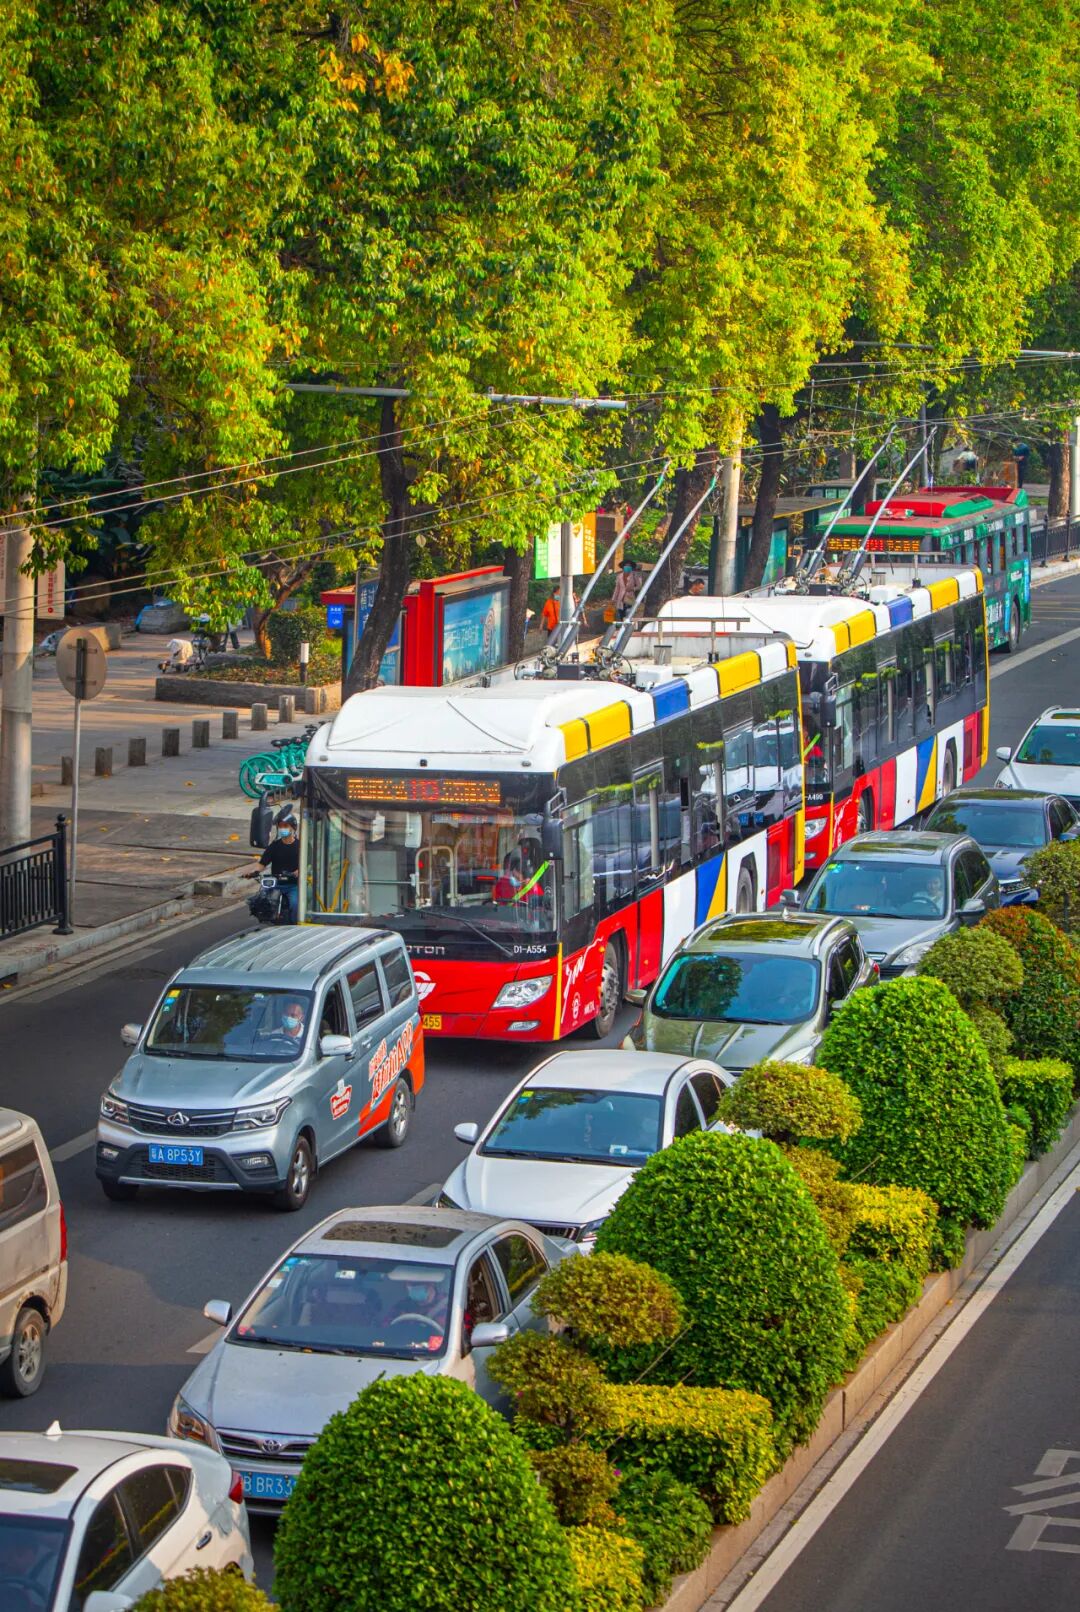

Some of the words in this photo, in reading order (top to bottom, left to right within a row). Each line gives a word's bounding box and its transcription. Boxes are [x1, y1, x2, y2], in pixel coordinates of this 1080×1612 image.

[513, 945, 547, 954] D1-A554
[167, 1148, 201, 1162] 8P53Y
[256, 1476, 296, 1496] BR33
